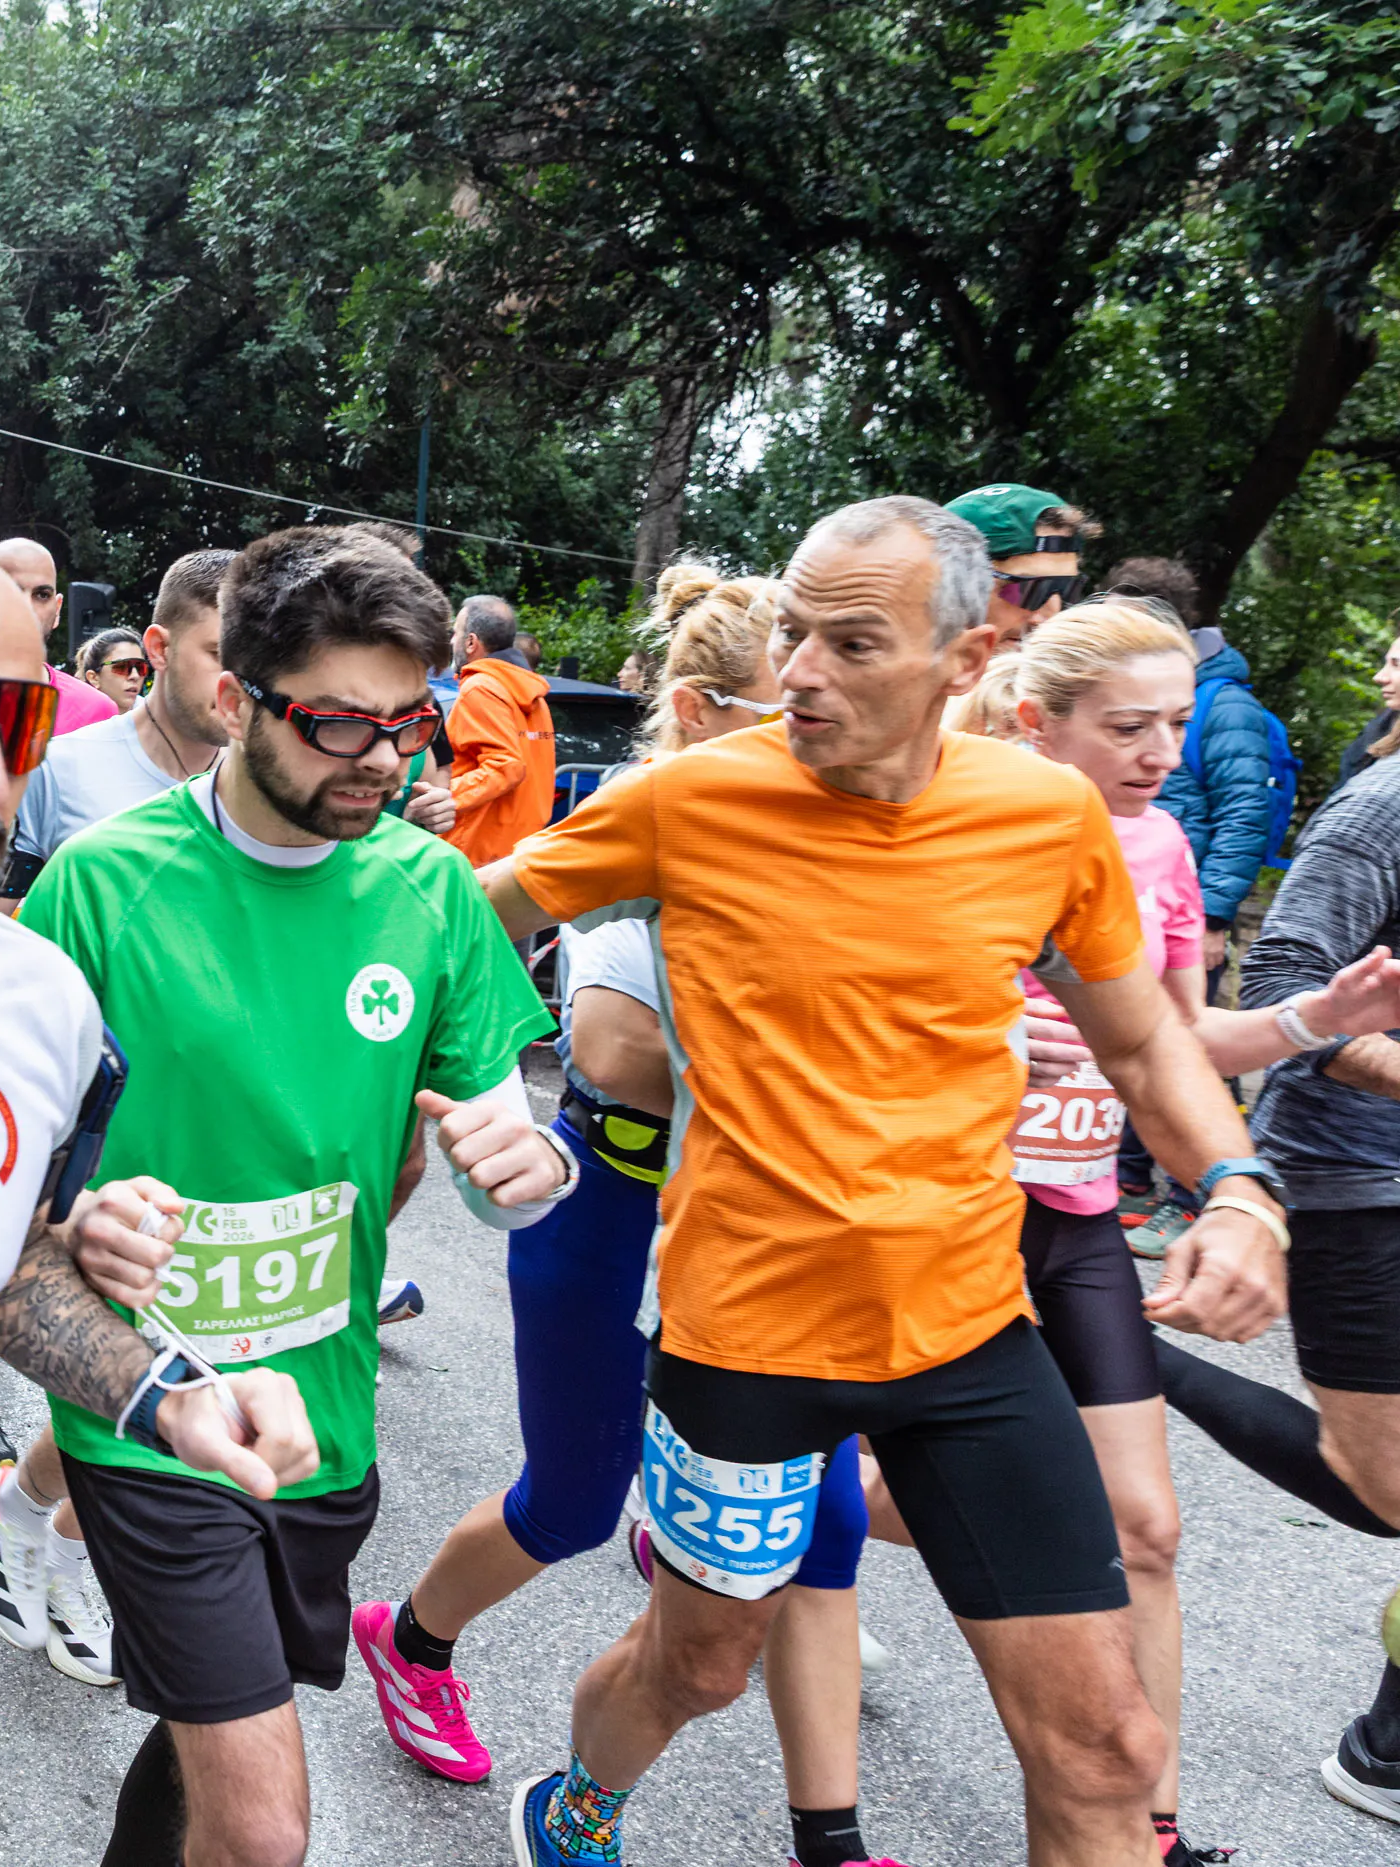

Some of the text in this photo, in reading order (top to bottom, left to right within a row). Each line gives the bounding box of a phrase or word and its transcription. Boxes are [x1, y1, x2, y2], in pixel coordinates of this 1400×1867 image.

[222, 1206, 237, 1217] 15
[222, 1218, 249, 1230] FEB
[222, 1230, 257, 1243] 2026
[156, 1231, 339, 1310] 5197
[193, 1304, 306, 1331] ΣΑΡΕΛΛΑΣ ΜΑΡΙΟΣ
[651, 1462, 805, 1554] 1255
